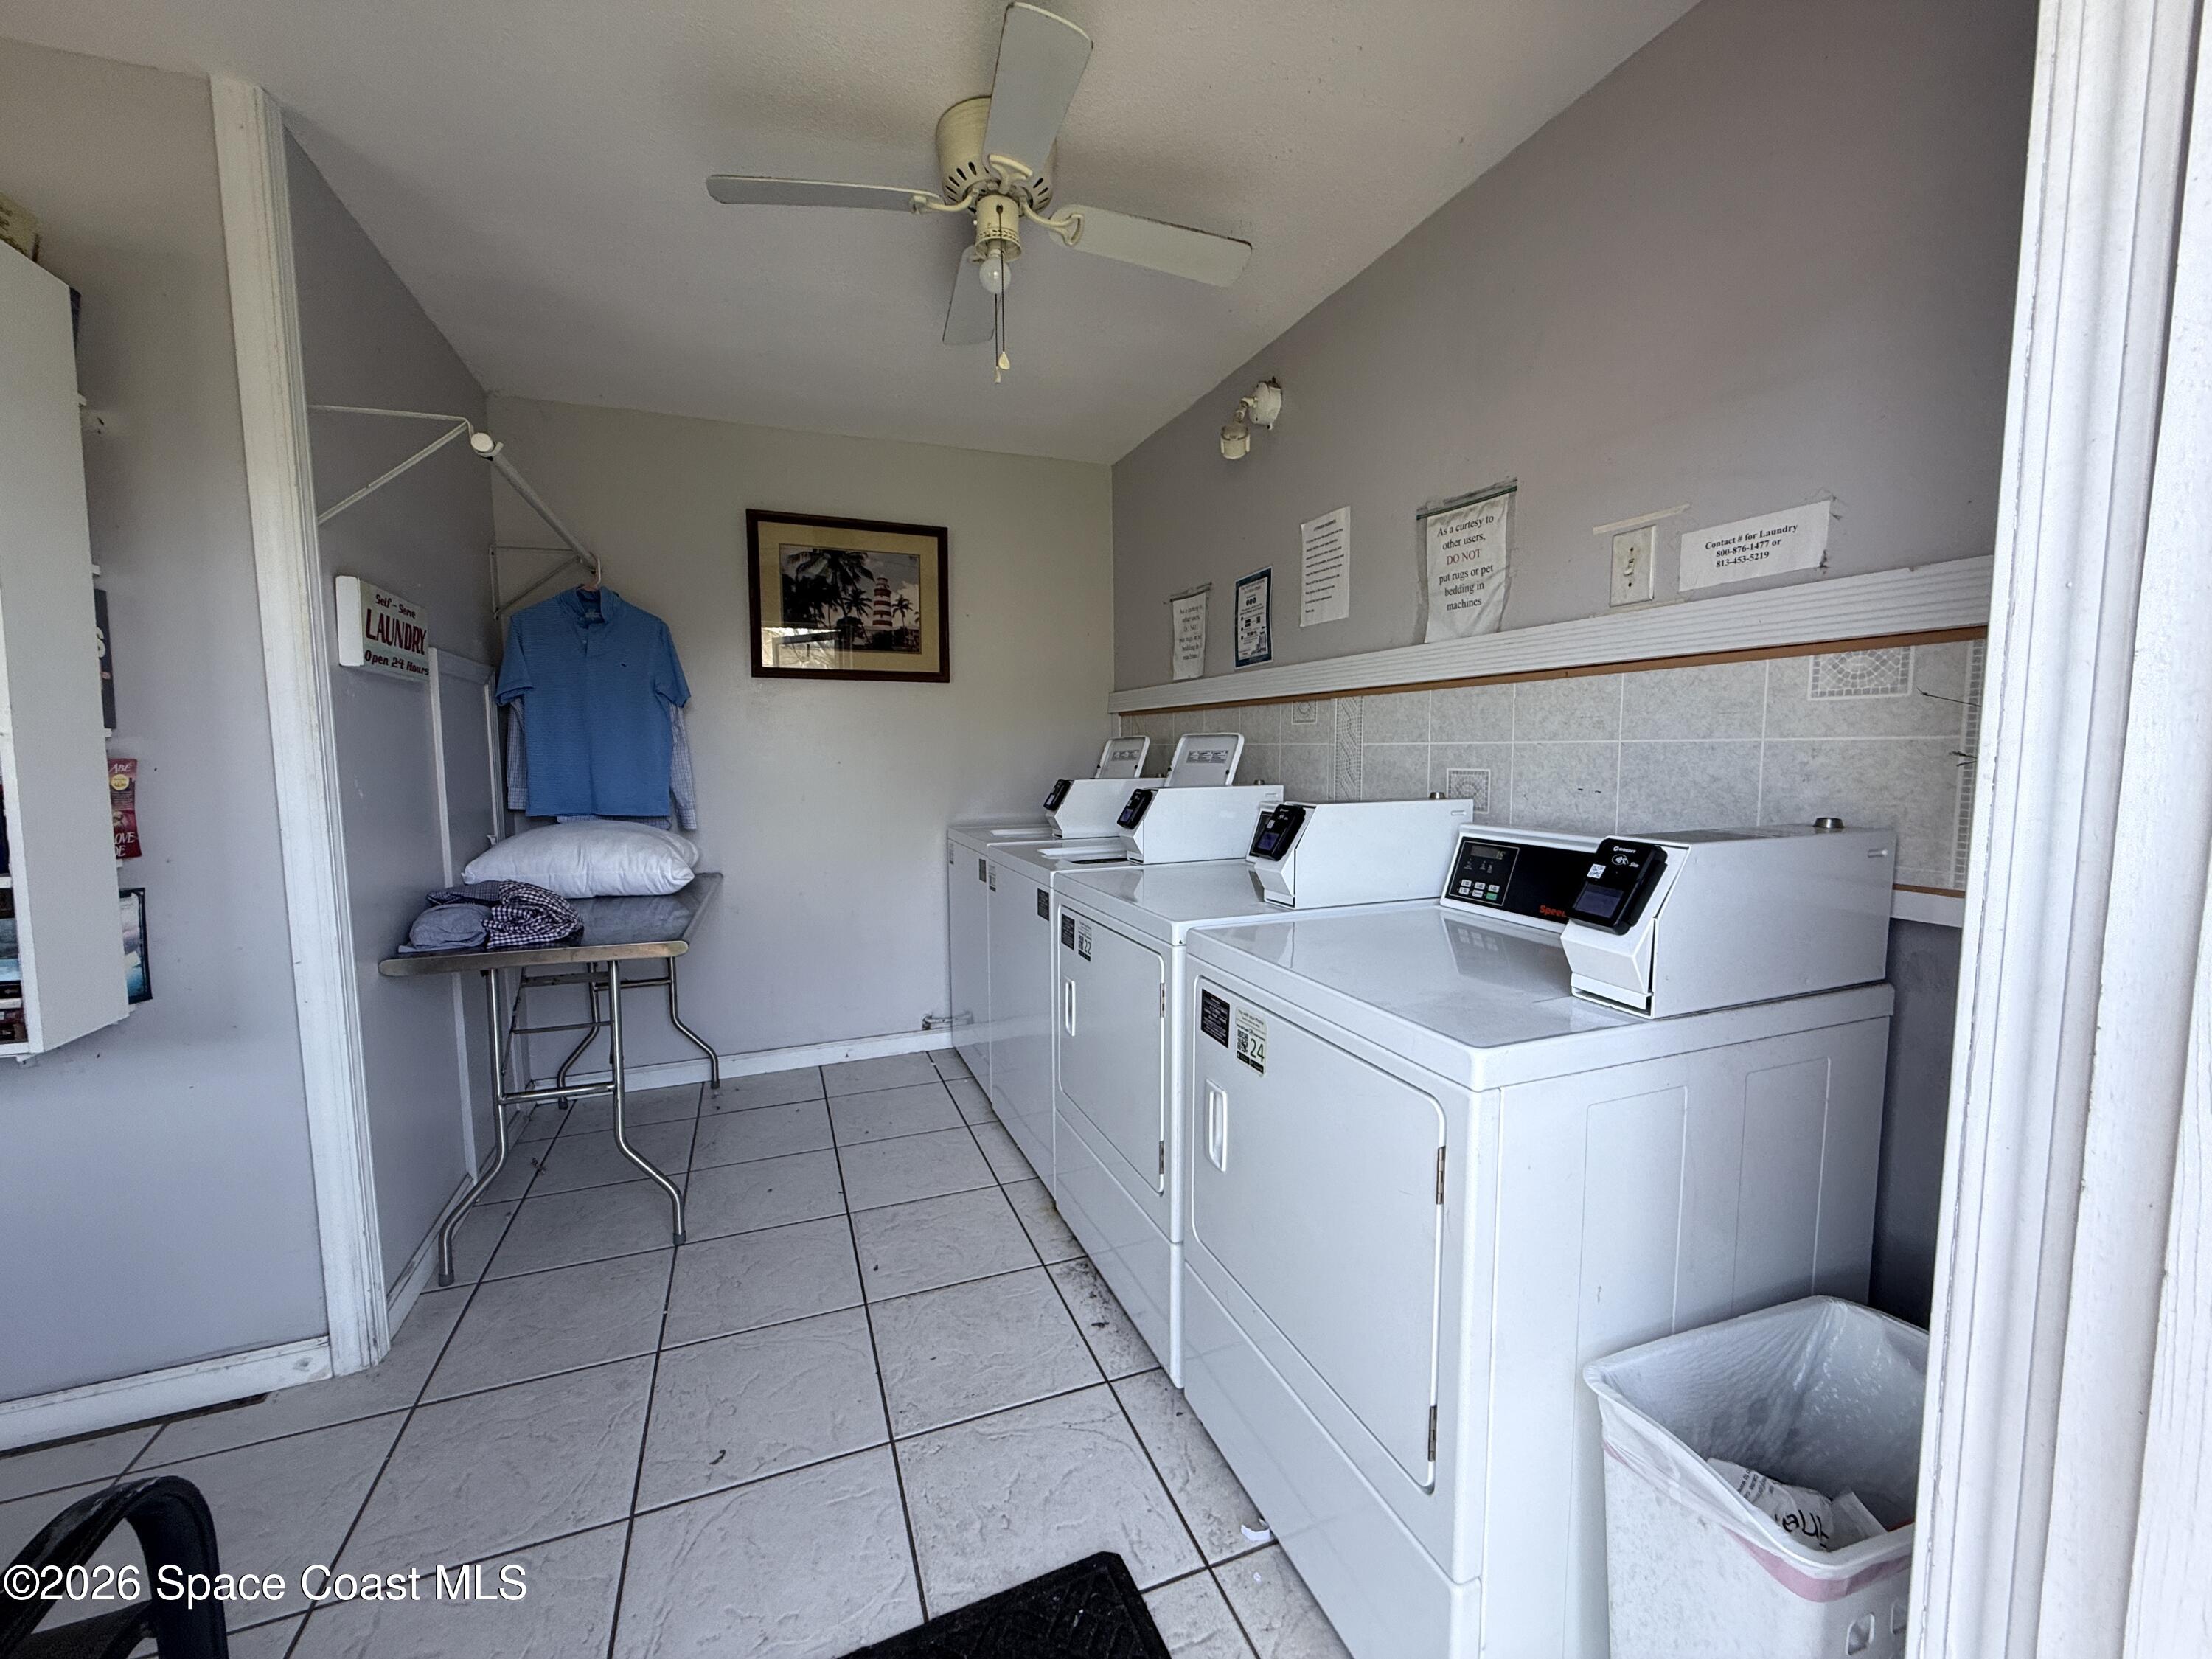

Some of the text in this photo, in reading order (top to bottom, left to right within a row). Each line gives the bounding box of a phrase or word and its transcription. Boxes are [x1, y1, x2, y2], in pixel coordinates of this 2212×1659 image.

[1437, 526, 1447, 537] As
[1455, 518, 1483, 532] curtesy
[1486, 515, 1494, 524] to
[1442, 532, 1486, 550] other users,
[1705, 538, 1736, 549] Contact
[1745, 532, 1757, 541] for
[1759, 524, 1799, 538] Laundry
[1716, 538, 1782, 557] 800-876-1477 or
[1447, 548, 1482, 566] DO NOT
[1716, 551, 1770, 568] 813-453-5219
[1439, 563, 1494, 585] put rugs or pet
[1444, 581, 1484, 597] bedding in
[375, 594, 392, 608] Self
[1447, 597, 1482, 611] machines
[366, 608, 427, 655] LAUNDRY
[364, 650, 430, 676] Open 24 Hours
[1084, 939, 1091, 955] 22
[1250, 1037, 1265, 1062] 24
